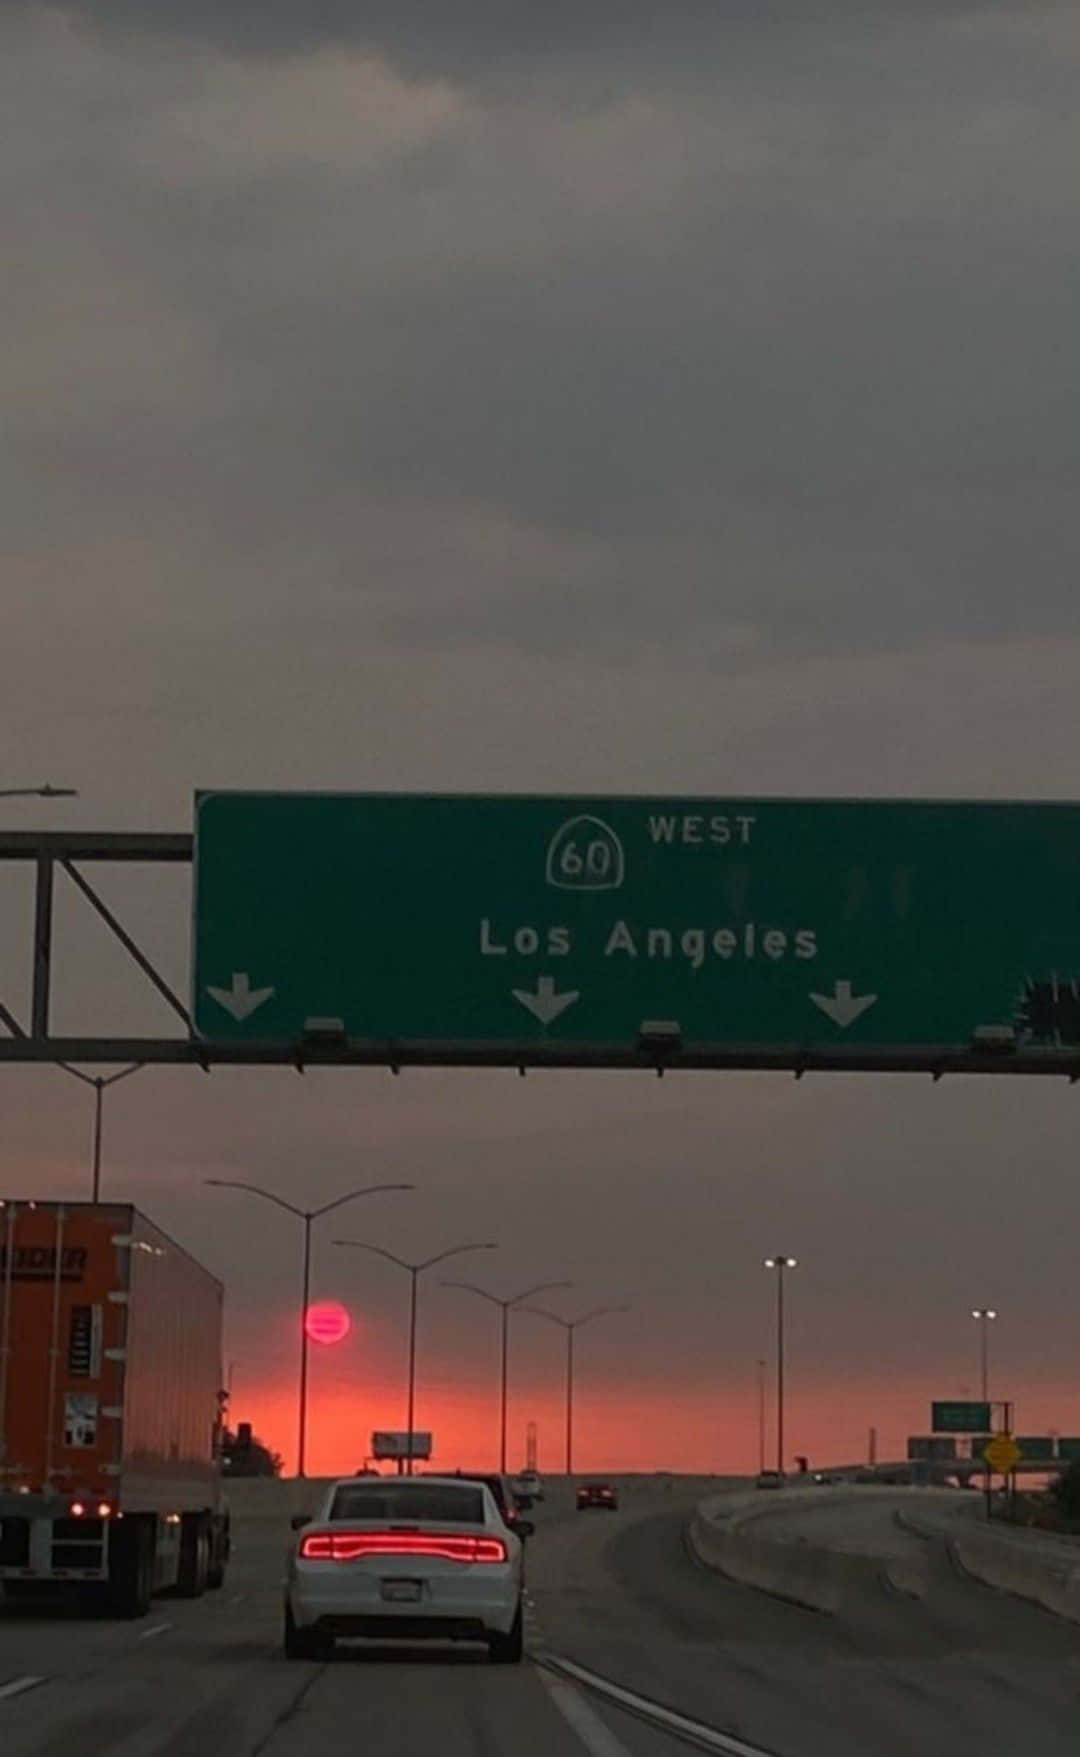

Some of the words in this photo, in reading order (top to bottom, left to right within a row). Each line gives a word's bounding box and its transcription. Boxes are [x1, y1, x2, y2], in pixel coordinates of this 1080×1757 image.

[649, 815, 757, 844] WEST
[560, 841, 611, 875] 60
[479, 917, 571, 955] Los
[604, 920, 818, 968] Angeles
